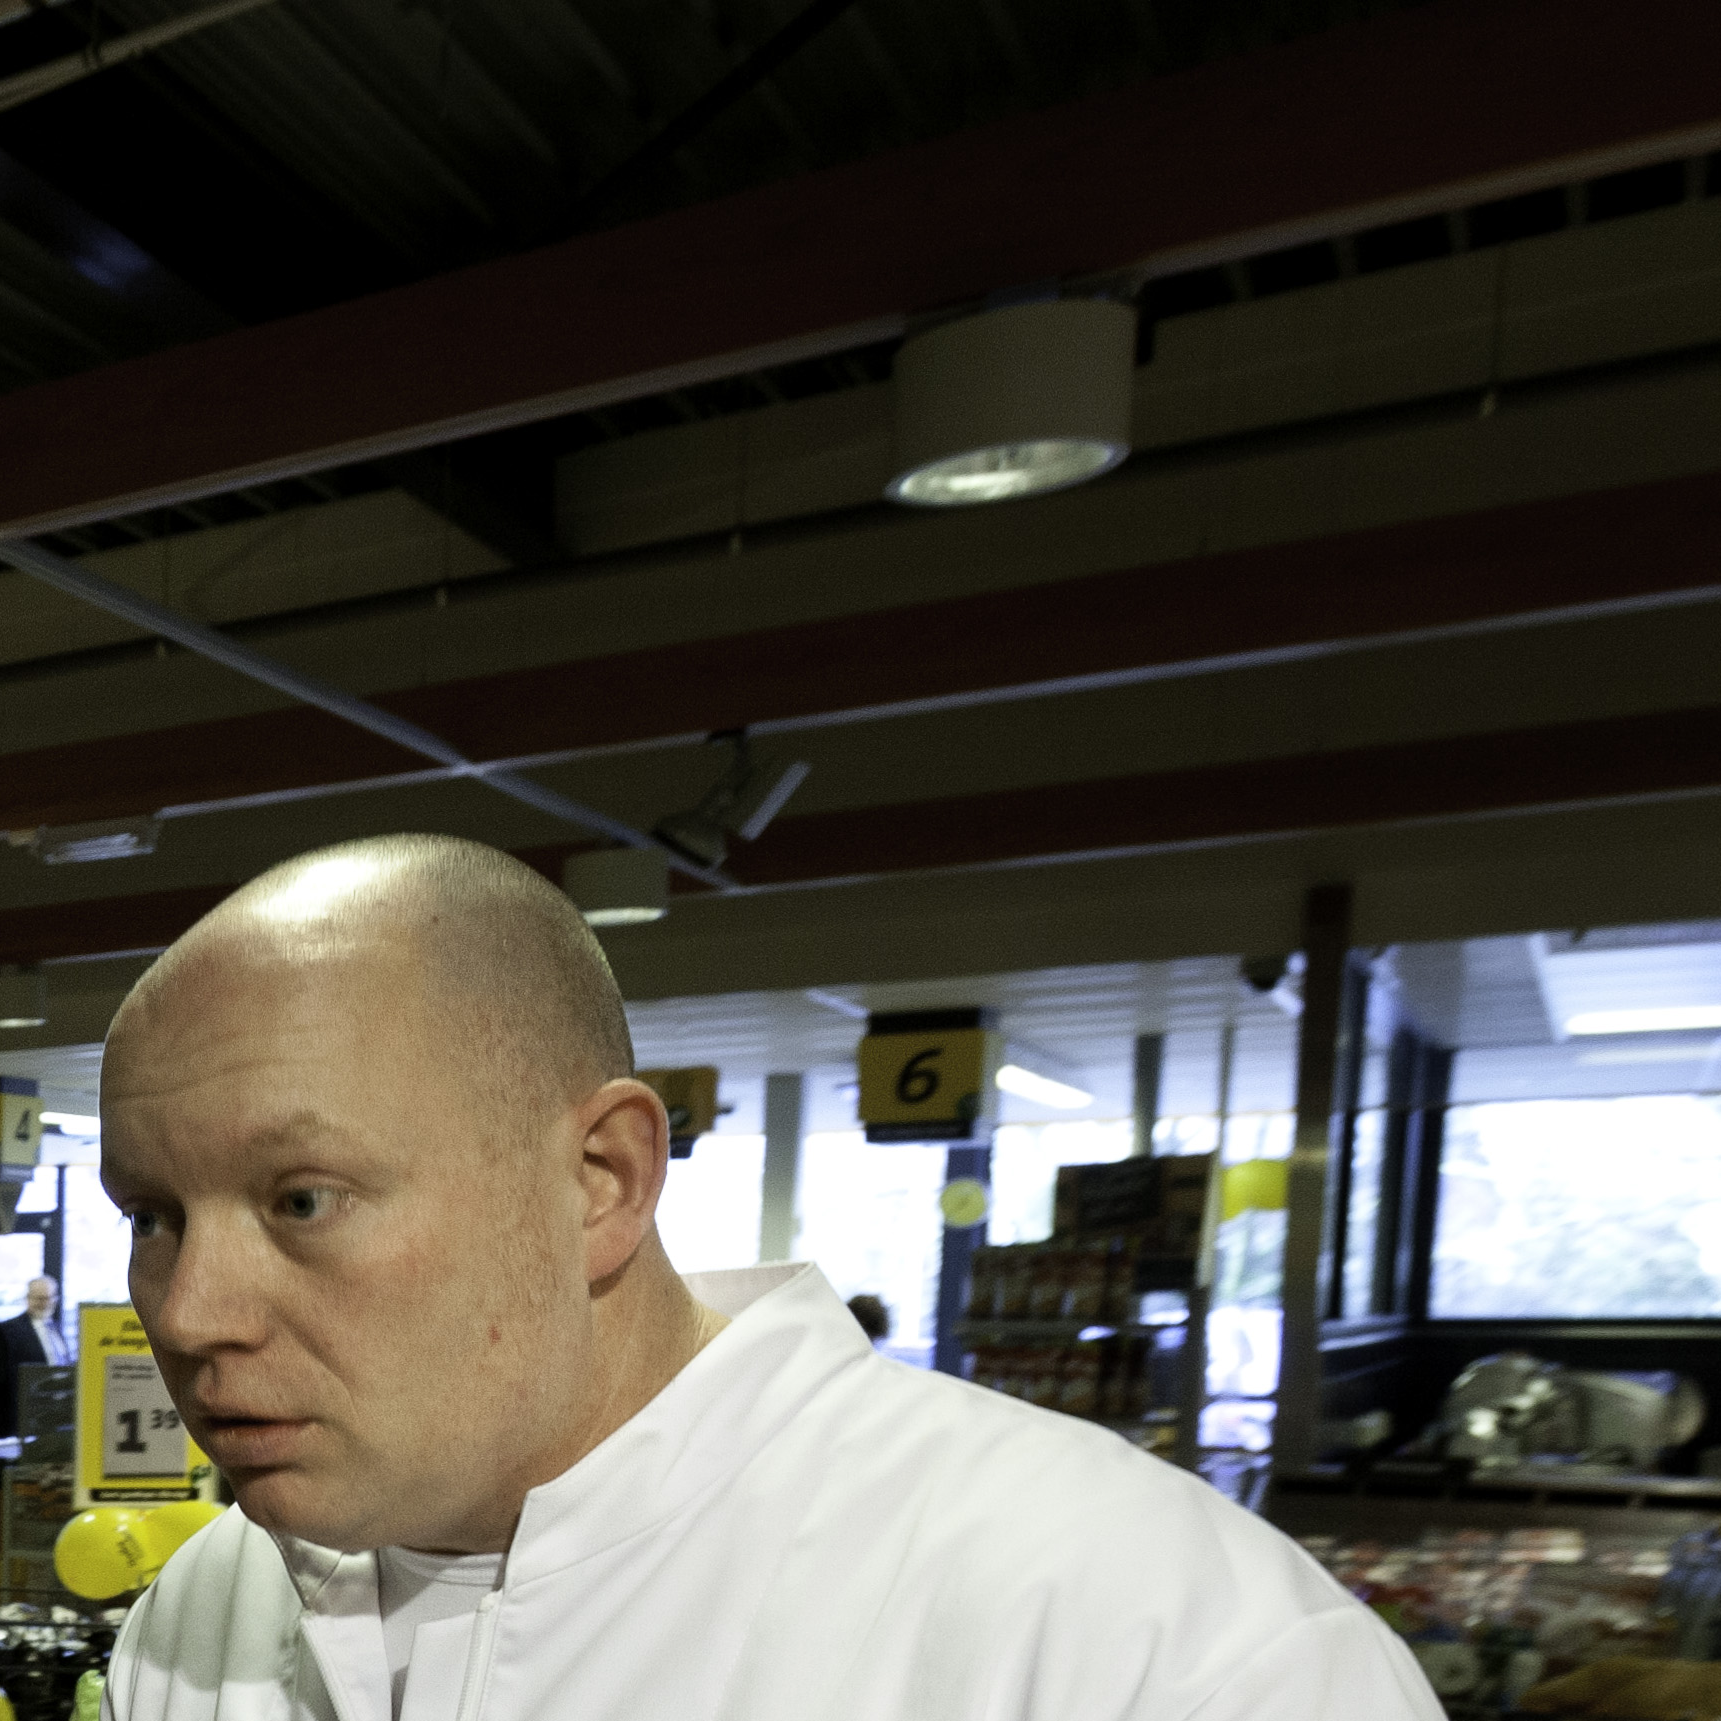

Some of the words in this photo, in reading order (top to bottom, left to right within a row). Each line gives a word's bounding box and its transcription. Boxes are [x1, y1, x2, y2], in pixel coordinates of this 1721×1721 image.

[895, 1046, 944, 1105] 6
[14, 1107, 31, 1143] 4
[115, 1408, 148, 1454] 1
